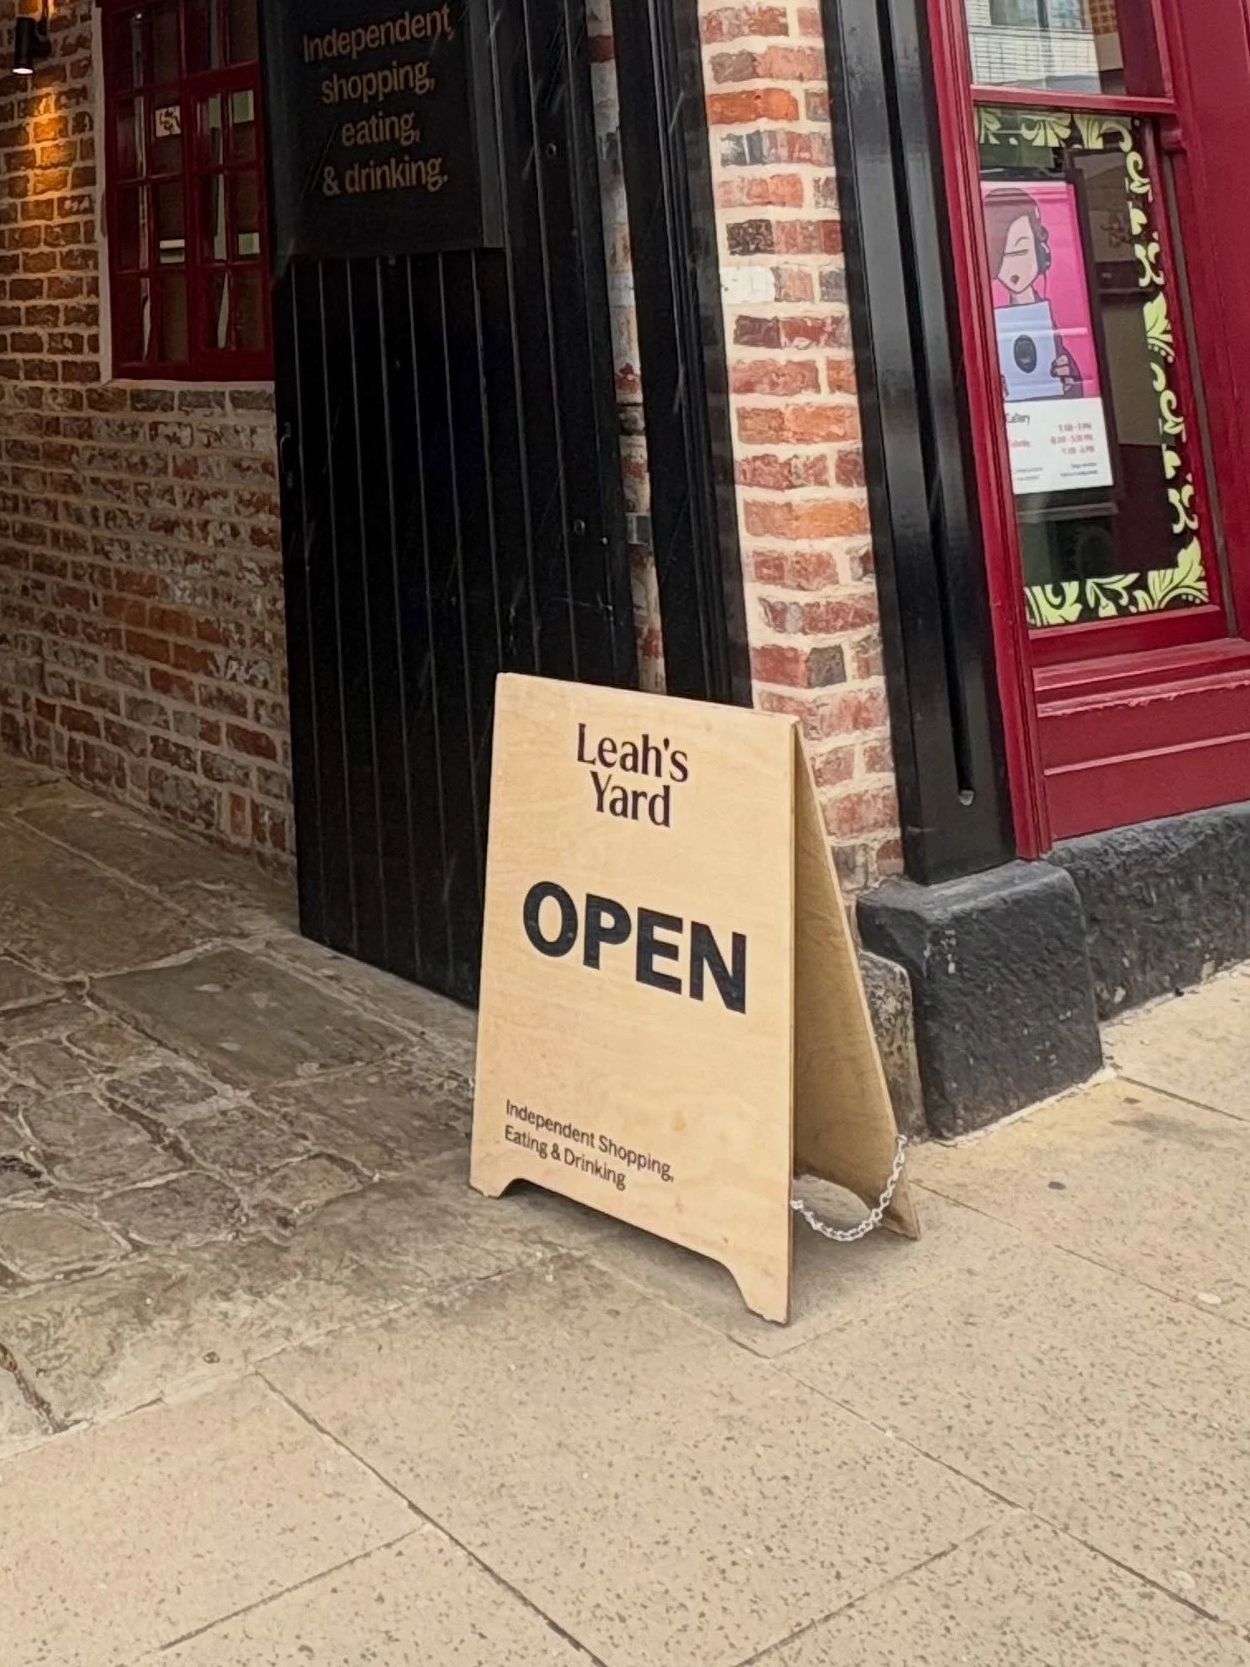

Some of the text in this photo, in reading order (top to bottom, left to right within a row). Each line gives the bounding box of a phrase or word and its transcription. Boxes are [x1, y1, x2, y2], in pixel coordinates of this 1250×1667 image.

[321, 60, 436, 104] shopping,
[341, 110, 420, 147] eating,
[322, 165, 340, 197] &
[577, 723, 689, 783] Leah's
[591, 771, 671, 828] Yard
[523, 880, 747, 1015] OPEN
[504, 1124, 627, 1192] Eating & Drinking
[505, 1098, 674, 1183] Independent Shopping,
